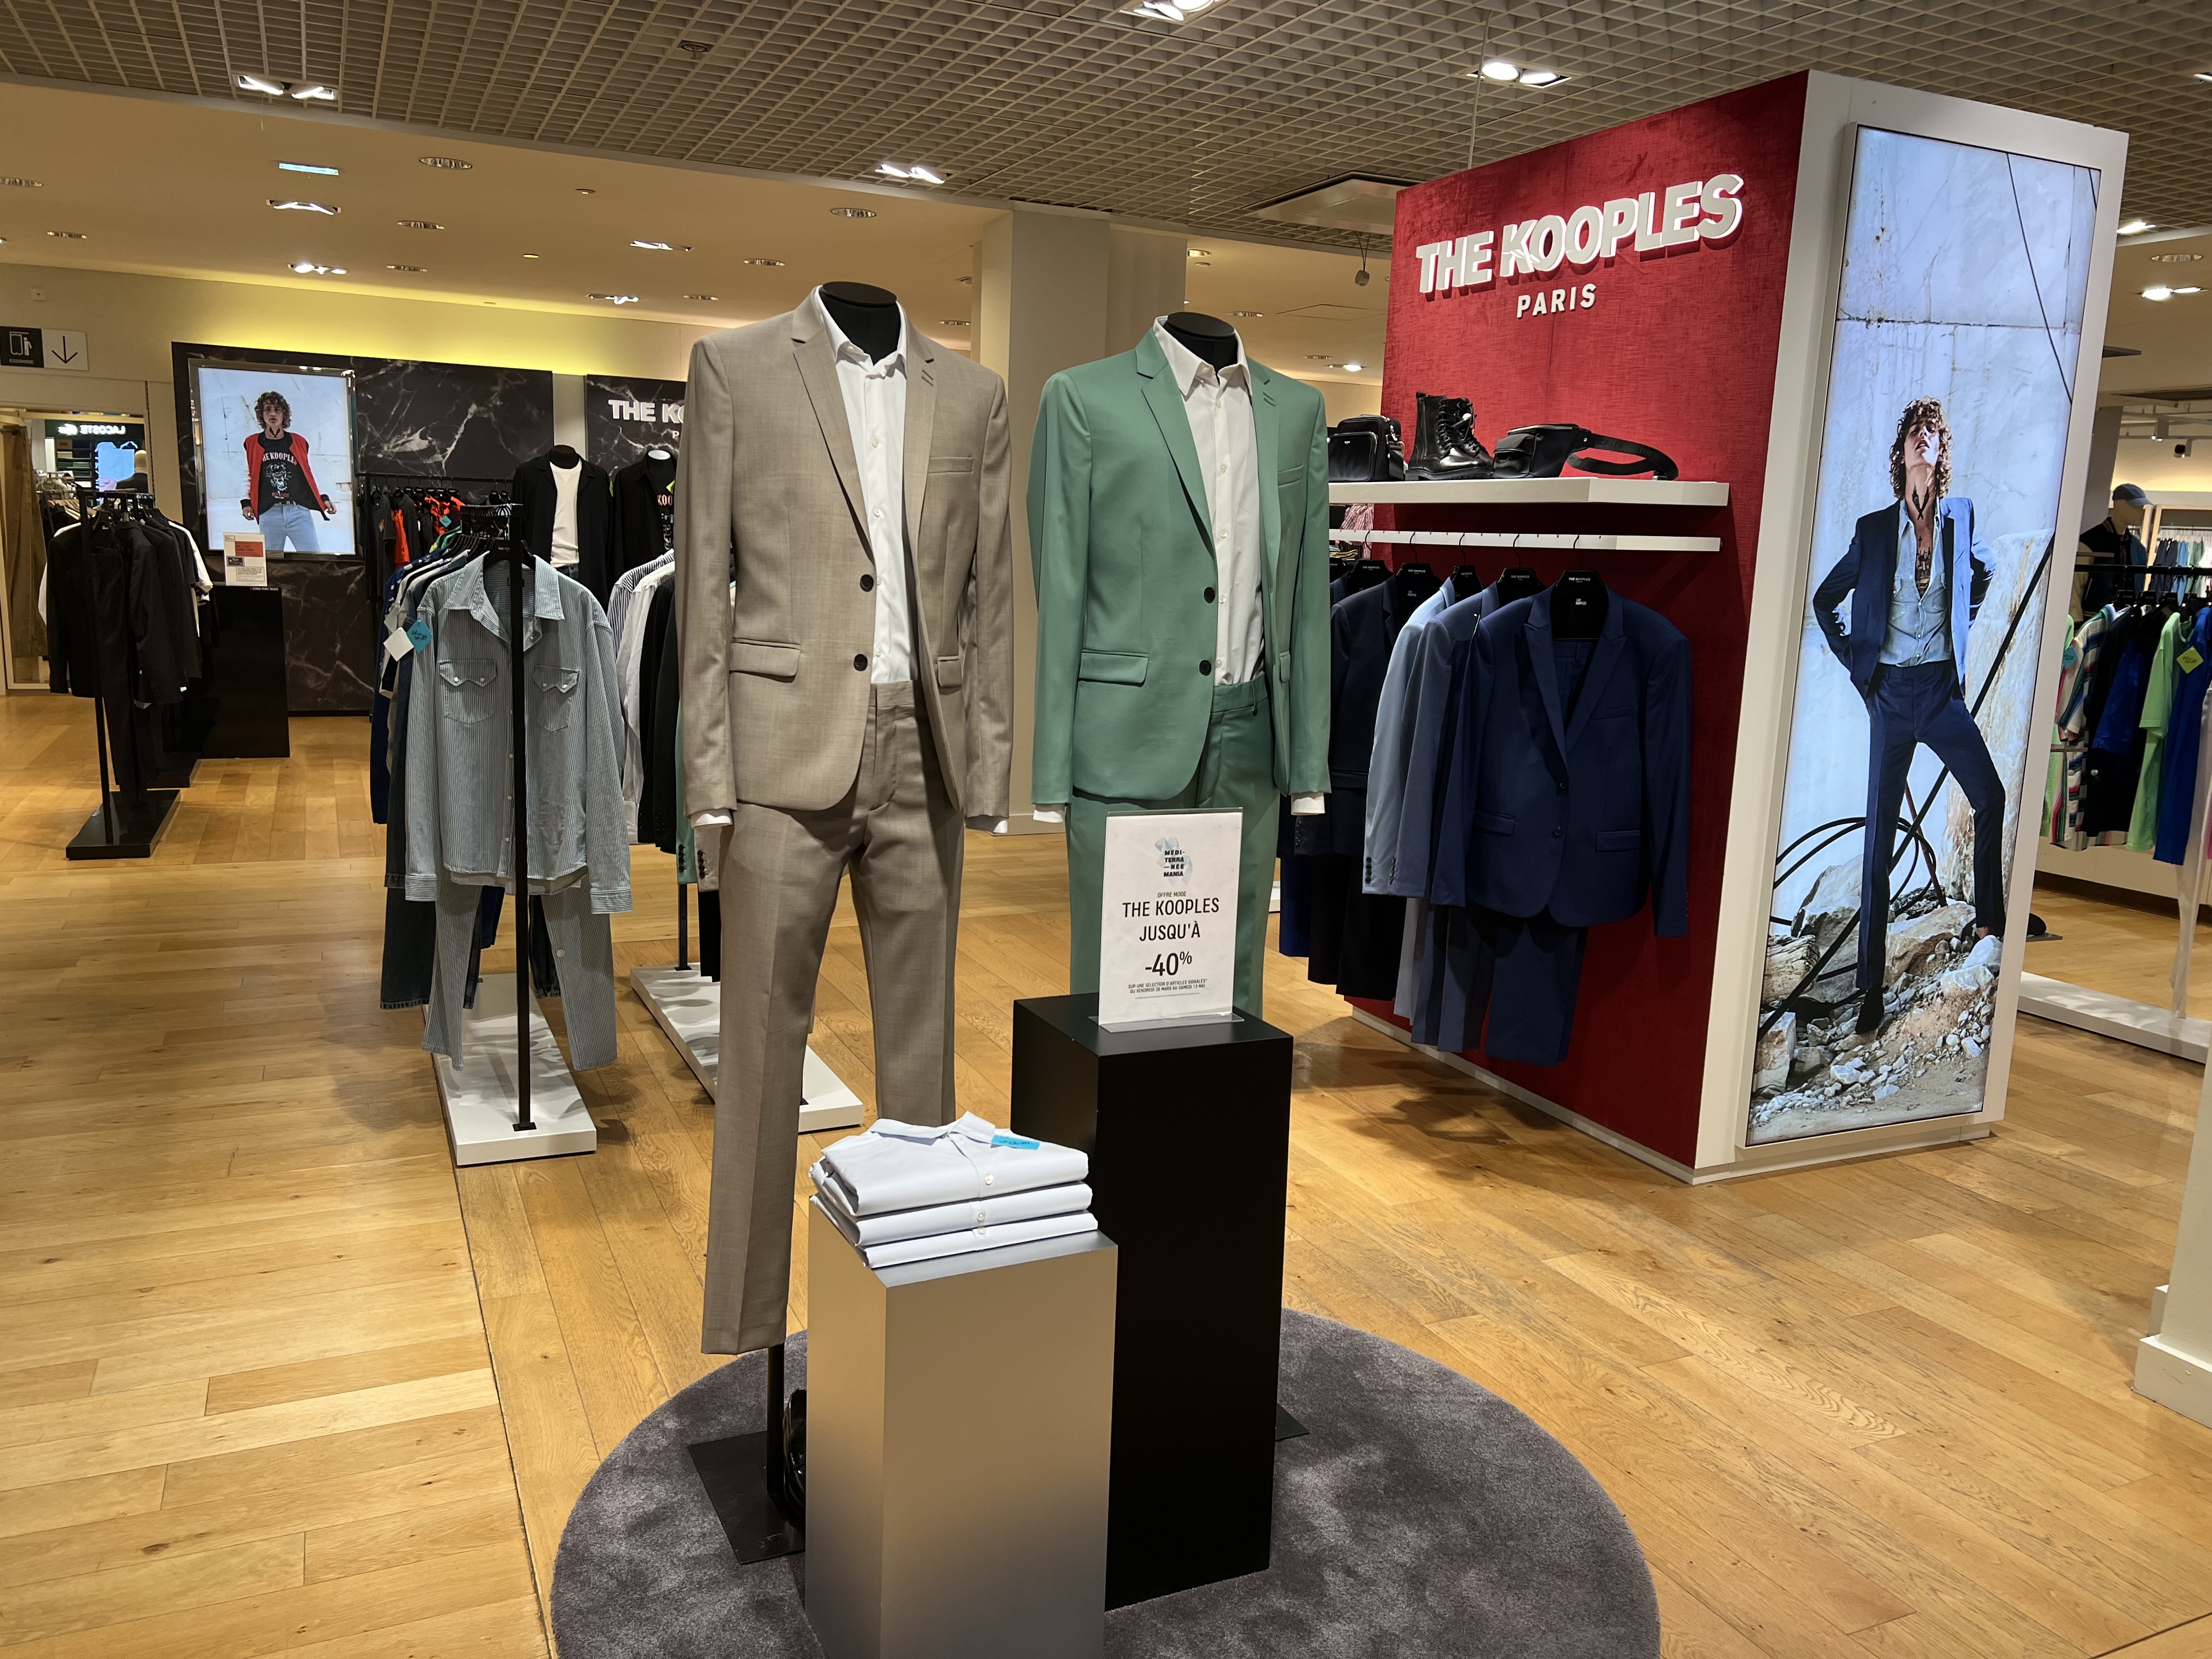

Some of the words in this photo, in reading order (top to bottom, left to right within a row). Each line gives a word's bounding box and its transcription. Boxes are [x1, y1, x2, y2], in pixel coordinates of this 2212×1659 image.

[1416, 230, 1494, 293] THE
[1499, 174, 1744, 277] KOOPLES
[1517, 283, 1596, 318] PARIS
[608, 399, 656, 422] THE
[1122, 901, 1150, 917] THE
[1155, 897, 1219, 916] KOOPLES
[1139, 920, 1200, 941] JUSQU'À
